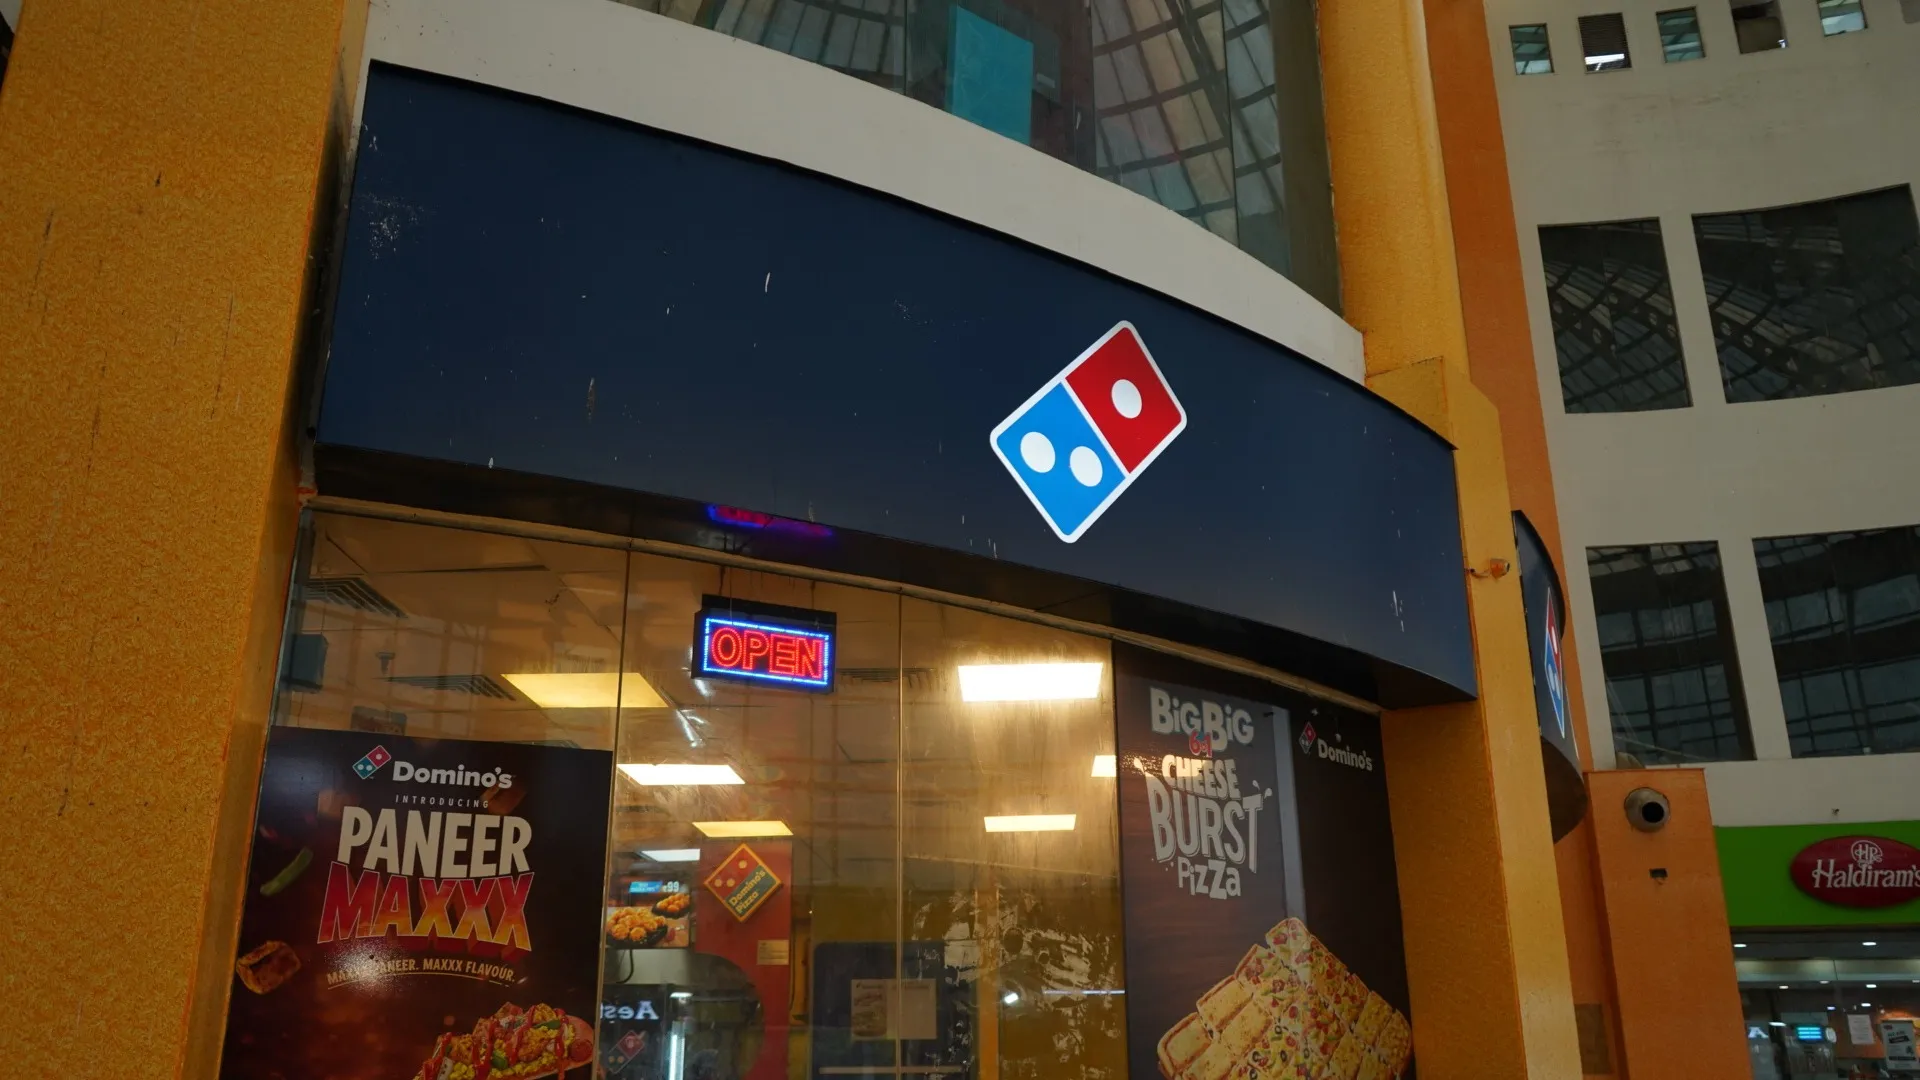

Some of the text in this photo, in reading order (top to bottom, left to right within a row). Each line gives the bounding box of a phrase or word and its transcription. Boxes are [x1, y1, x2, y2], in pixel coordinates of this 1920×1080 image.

[711, 627, 823, 679] OPEN
[1318, 738, 1373, 771] Domino's
[392, 761, 513, 789] Domino's
[1162, 754, 1241, 799] CHEESE
[395, 794, 489, 809] INTRODUCING
[1145, 771, 1264, 873] BURST
[338, 806, 532, 877] PANEER
[729, 870, 766, 906] Domino's
[1812, 859, 1920, 888] Haldiram's
[317, 861, 534, 952] MAXXX
[735, 891, 758, 914] Pizza
[423, 958, 462, 972] MAXXX
[465, 961, 515, 982] FLAVOUR.
